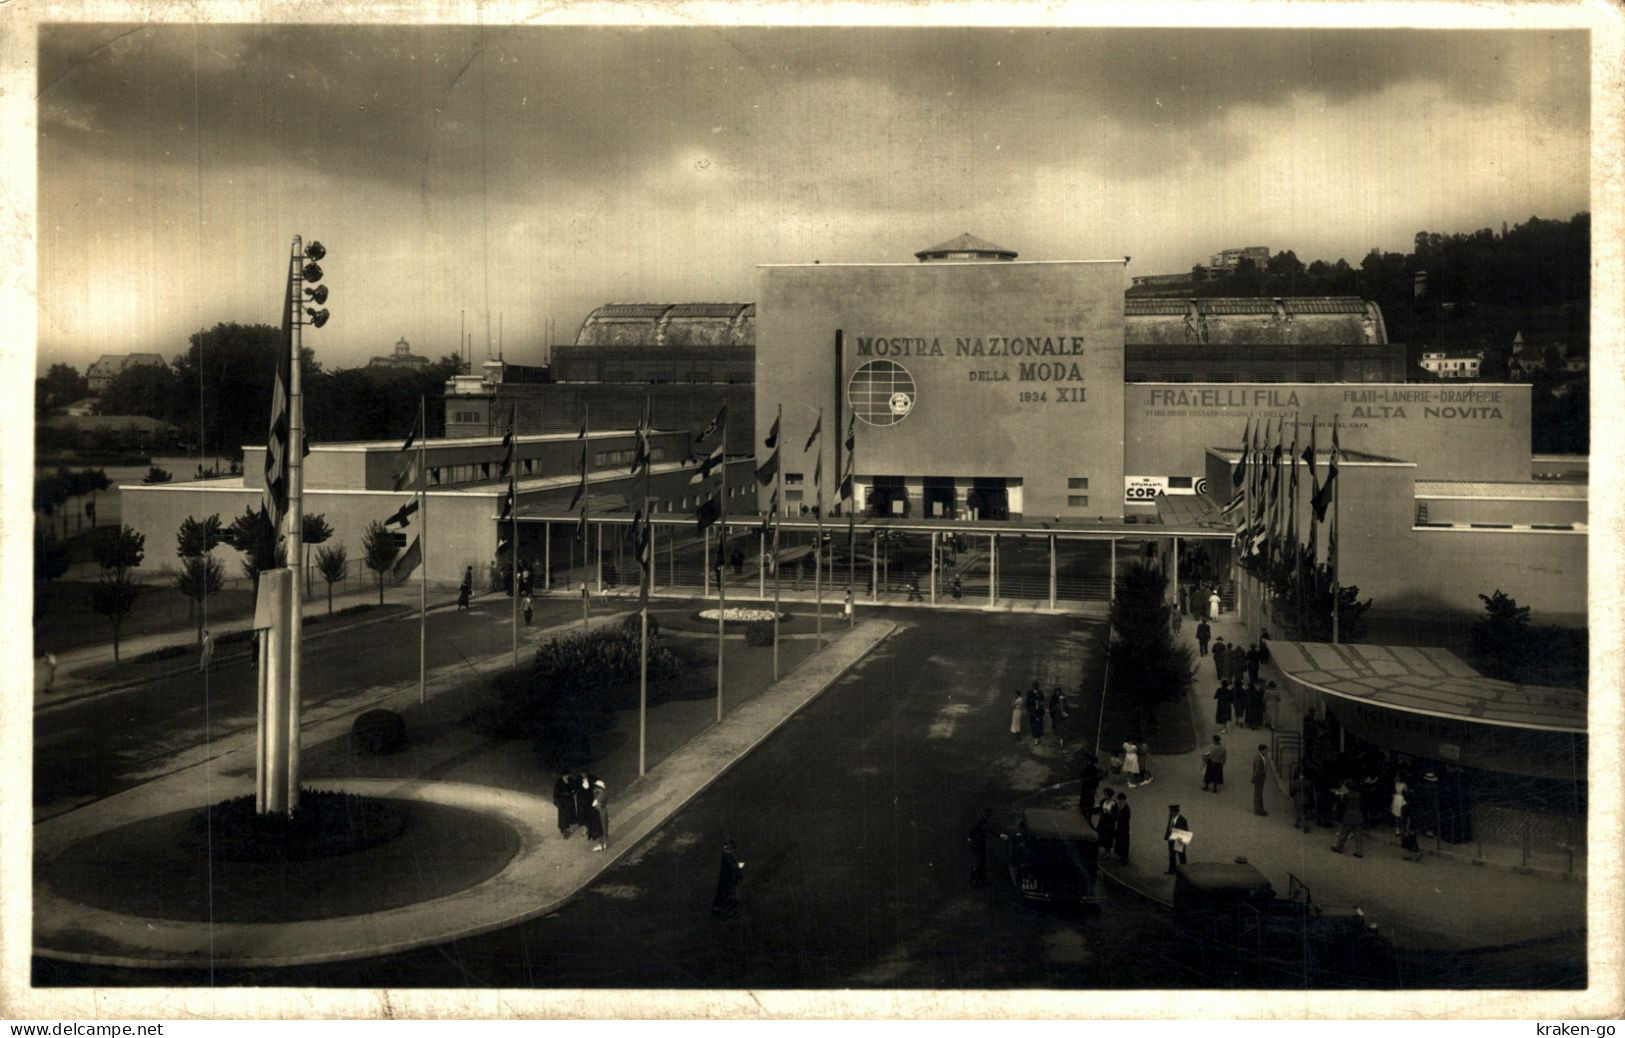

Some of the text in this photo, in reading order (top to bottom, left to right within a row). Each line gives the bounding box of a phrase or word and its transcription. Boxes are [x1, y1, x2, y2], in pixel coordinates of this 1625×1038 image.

[857, 336, 1085, 356] MOSTRA NAZIONALE
[969, 362, 1083, 382] DELLA MODA
[1020, 387, 1086, 402] 1934 XII
[1150, 389, 1299, 407] FRATELLI FILA
[1352, 407, 1503, 419] ALTA NOVITA
[1126, 488, 1166, 497] CORA
